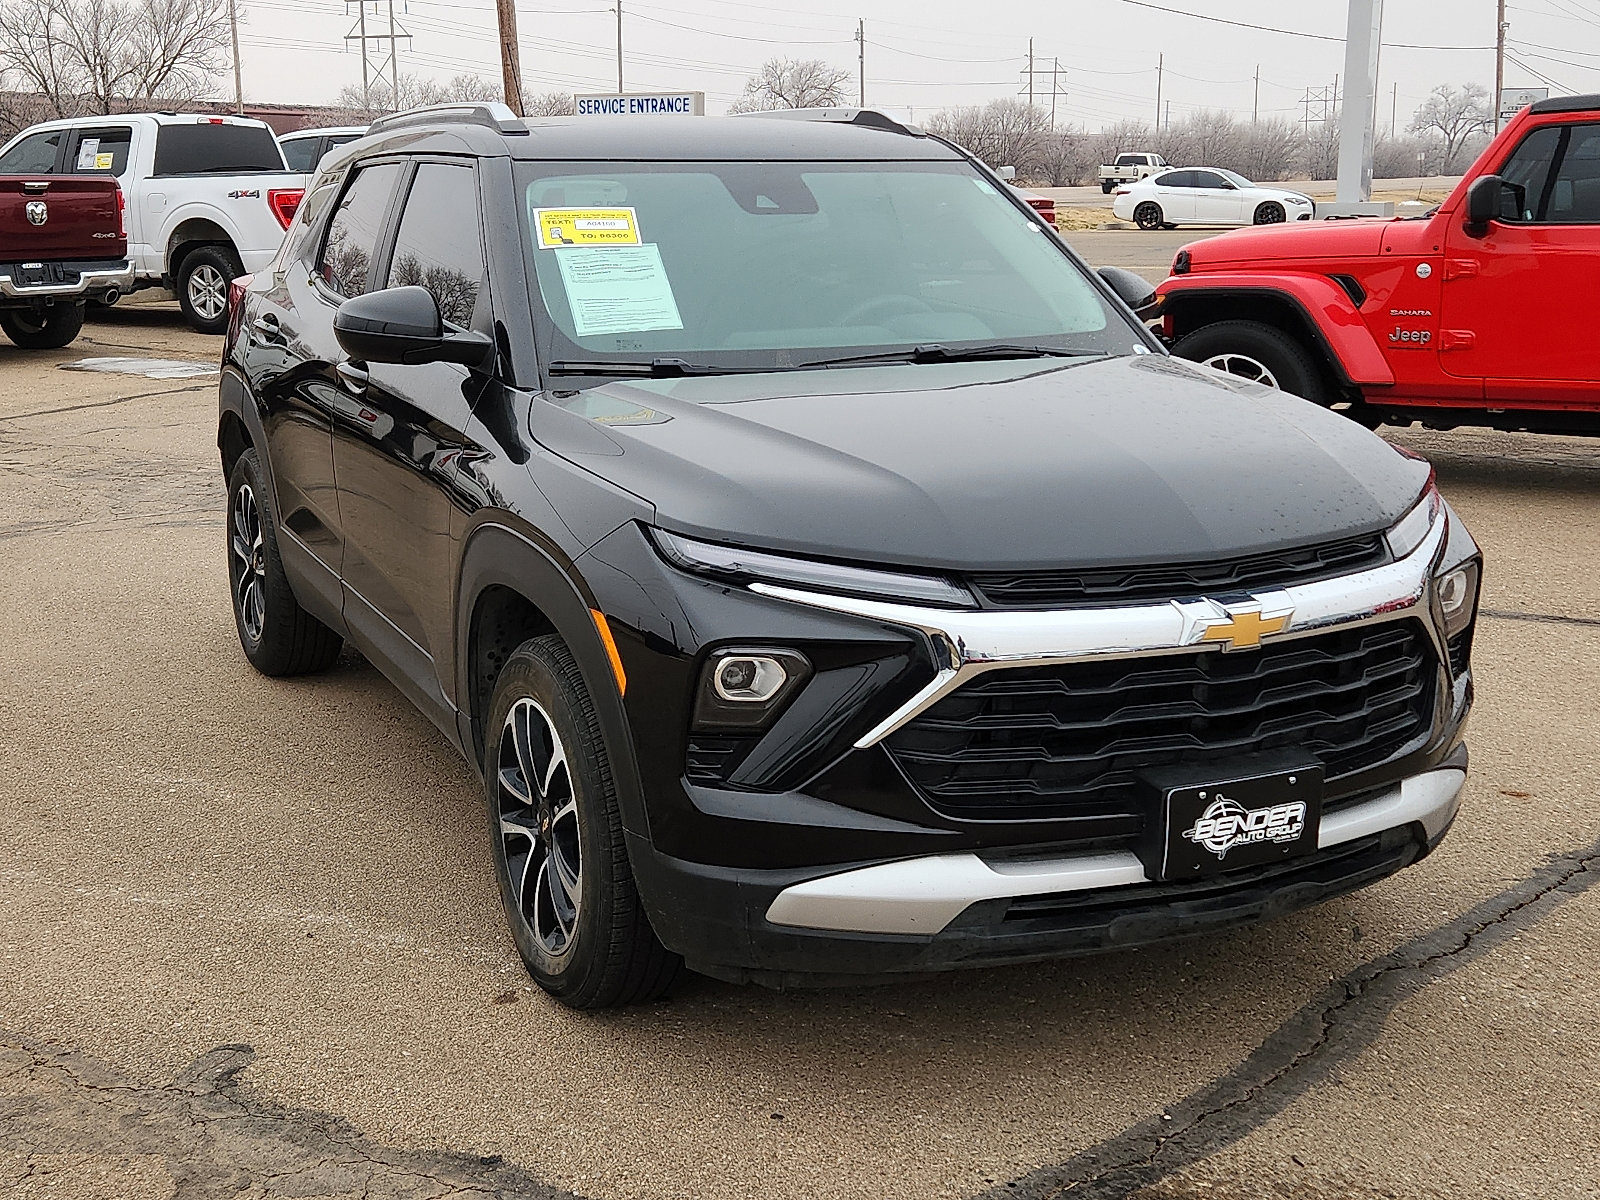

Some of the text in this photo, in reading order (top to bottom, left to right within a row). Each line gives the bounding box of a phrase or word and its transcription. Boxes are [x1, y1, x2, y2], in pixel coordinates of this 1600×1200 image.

[578, 97, 690, 115] SERVICE ENTRANCE
[1388, 326, 1431, 345] Jeep
[1194, 803, 1305, 840] BENDER
[1235, 829, 1265, 843] AUTO
[1266, 822, 1303, 838] GROUP
